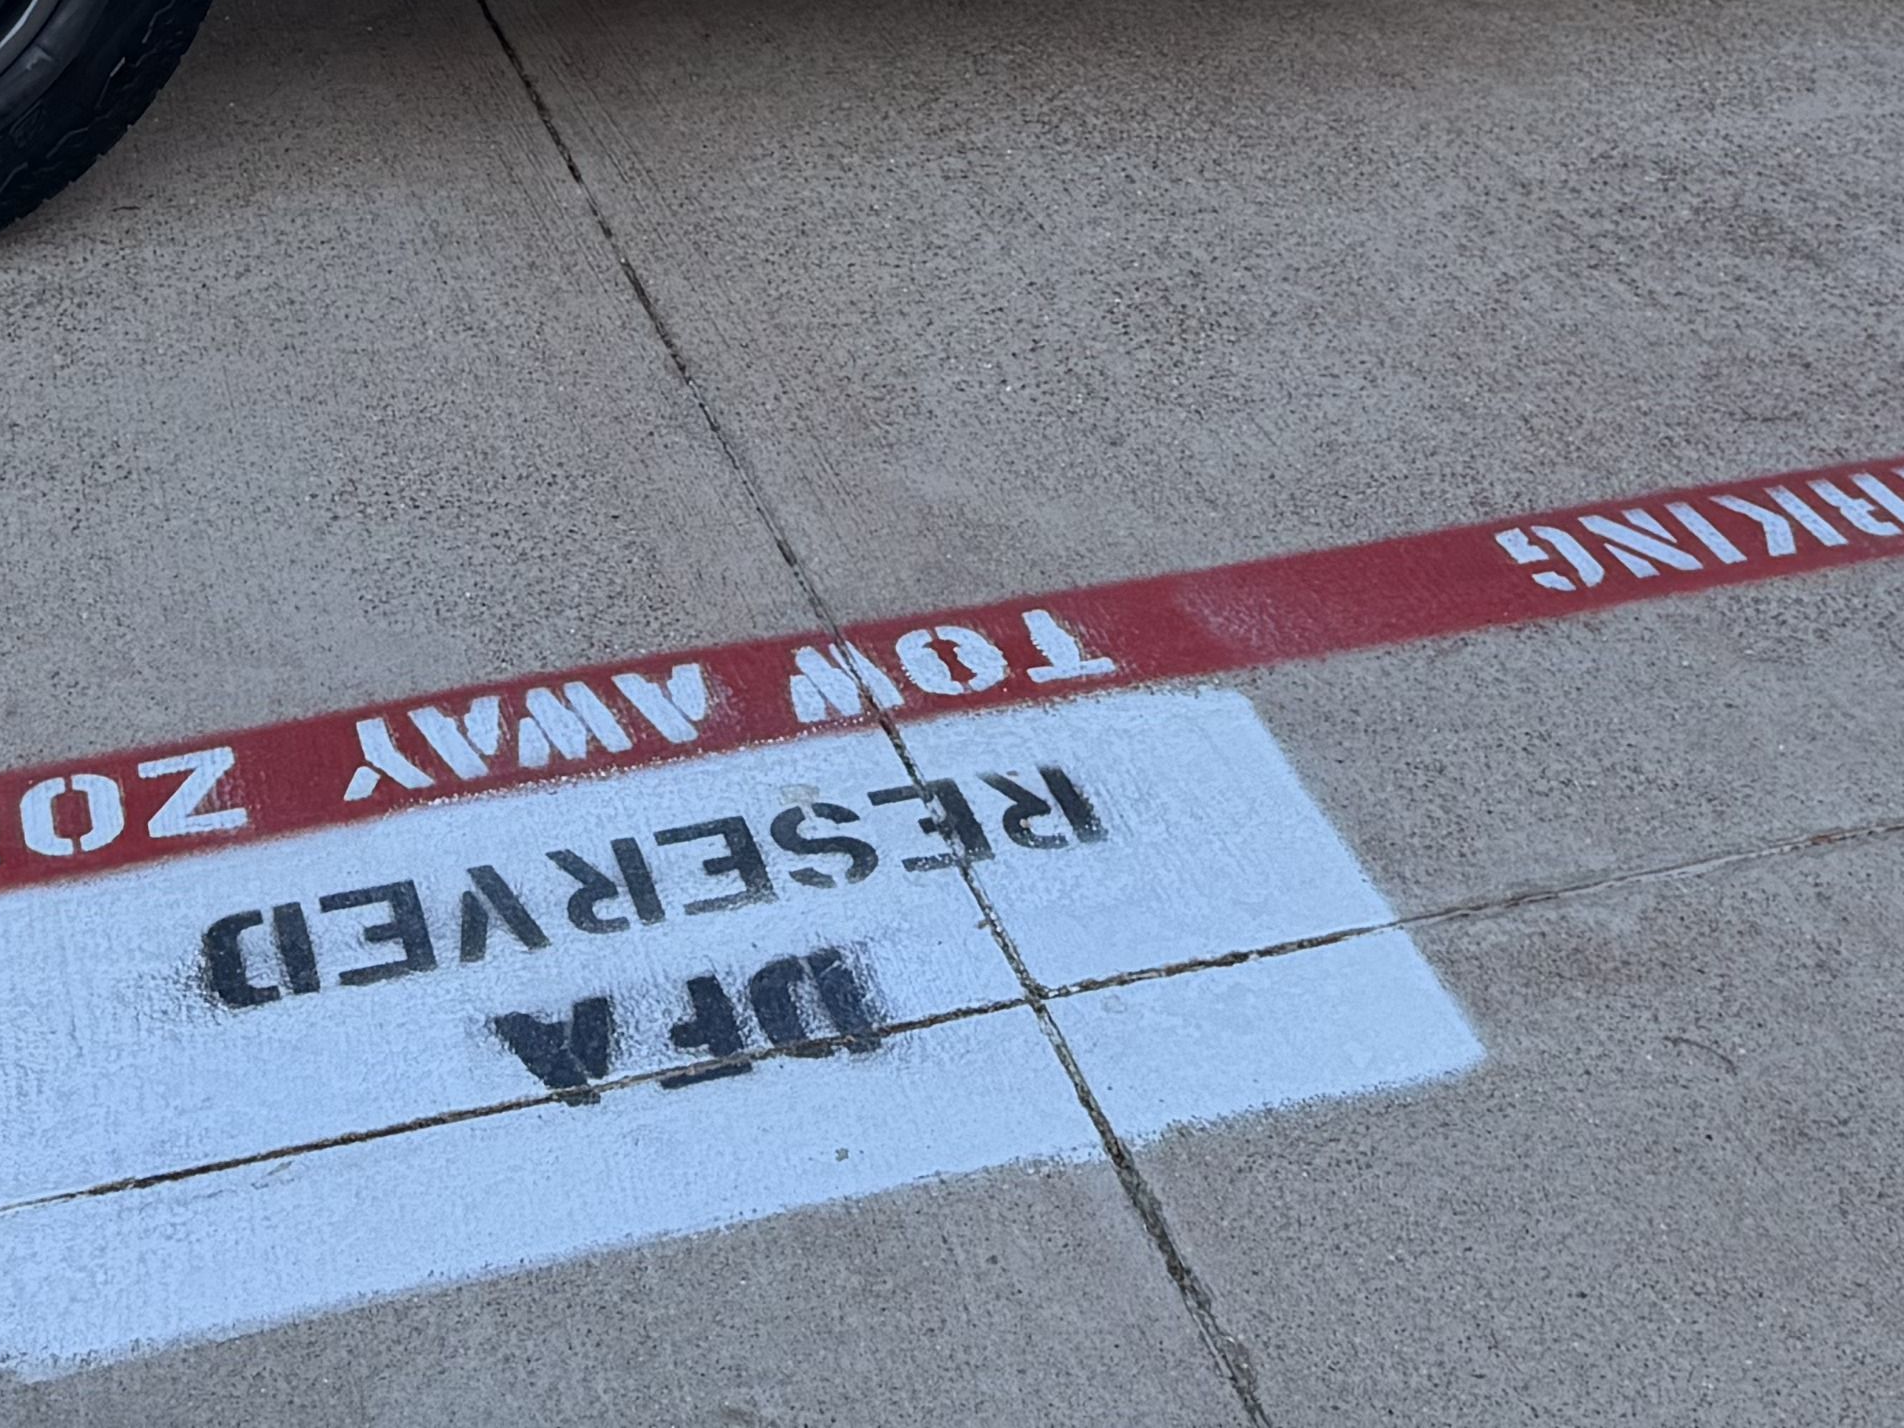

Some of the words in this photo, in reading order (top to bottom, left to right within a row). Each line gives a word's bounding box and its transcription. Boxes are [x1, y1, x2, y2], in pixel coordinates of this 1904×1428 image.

[343, 662, 708, 802] AWAY
[789, 608, 1116, 724] TOW
[201, 764, 1110, 1011] RESERVED
[492, 946, 884, 1106] DFA
